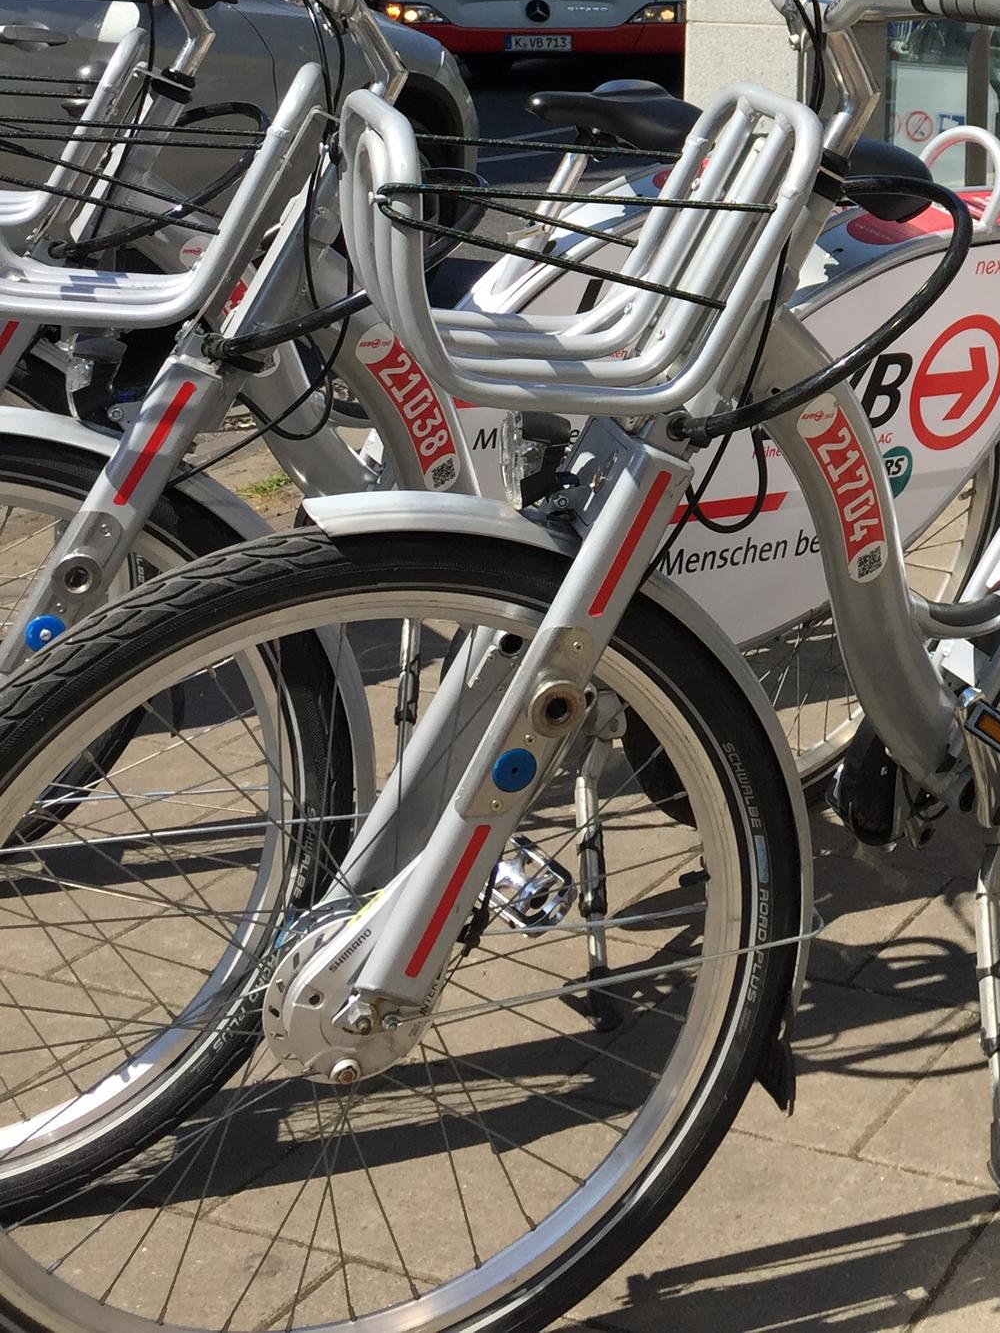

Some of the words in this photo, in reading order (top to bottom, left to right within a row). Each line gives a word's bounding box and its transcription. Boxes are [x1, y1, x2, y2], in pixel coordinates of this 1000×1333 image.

[546, 37, 567, 47] 713
[378, 353, 449, 457] 21038
[878, 432, 893, 444] AG
[817, 426, 880, 542] 21704
[885, 457, 905, 476] RS
[660, 537, 789, 576] Menschen
[722, 742, 762, 828] SCHWALBE
[757, 888, 770, 942] ROAD
[328, 928, 373, 973] SHIMANO
[747, 950, 765, 1003] PLUS
